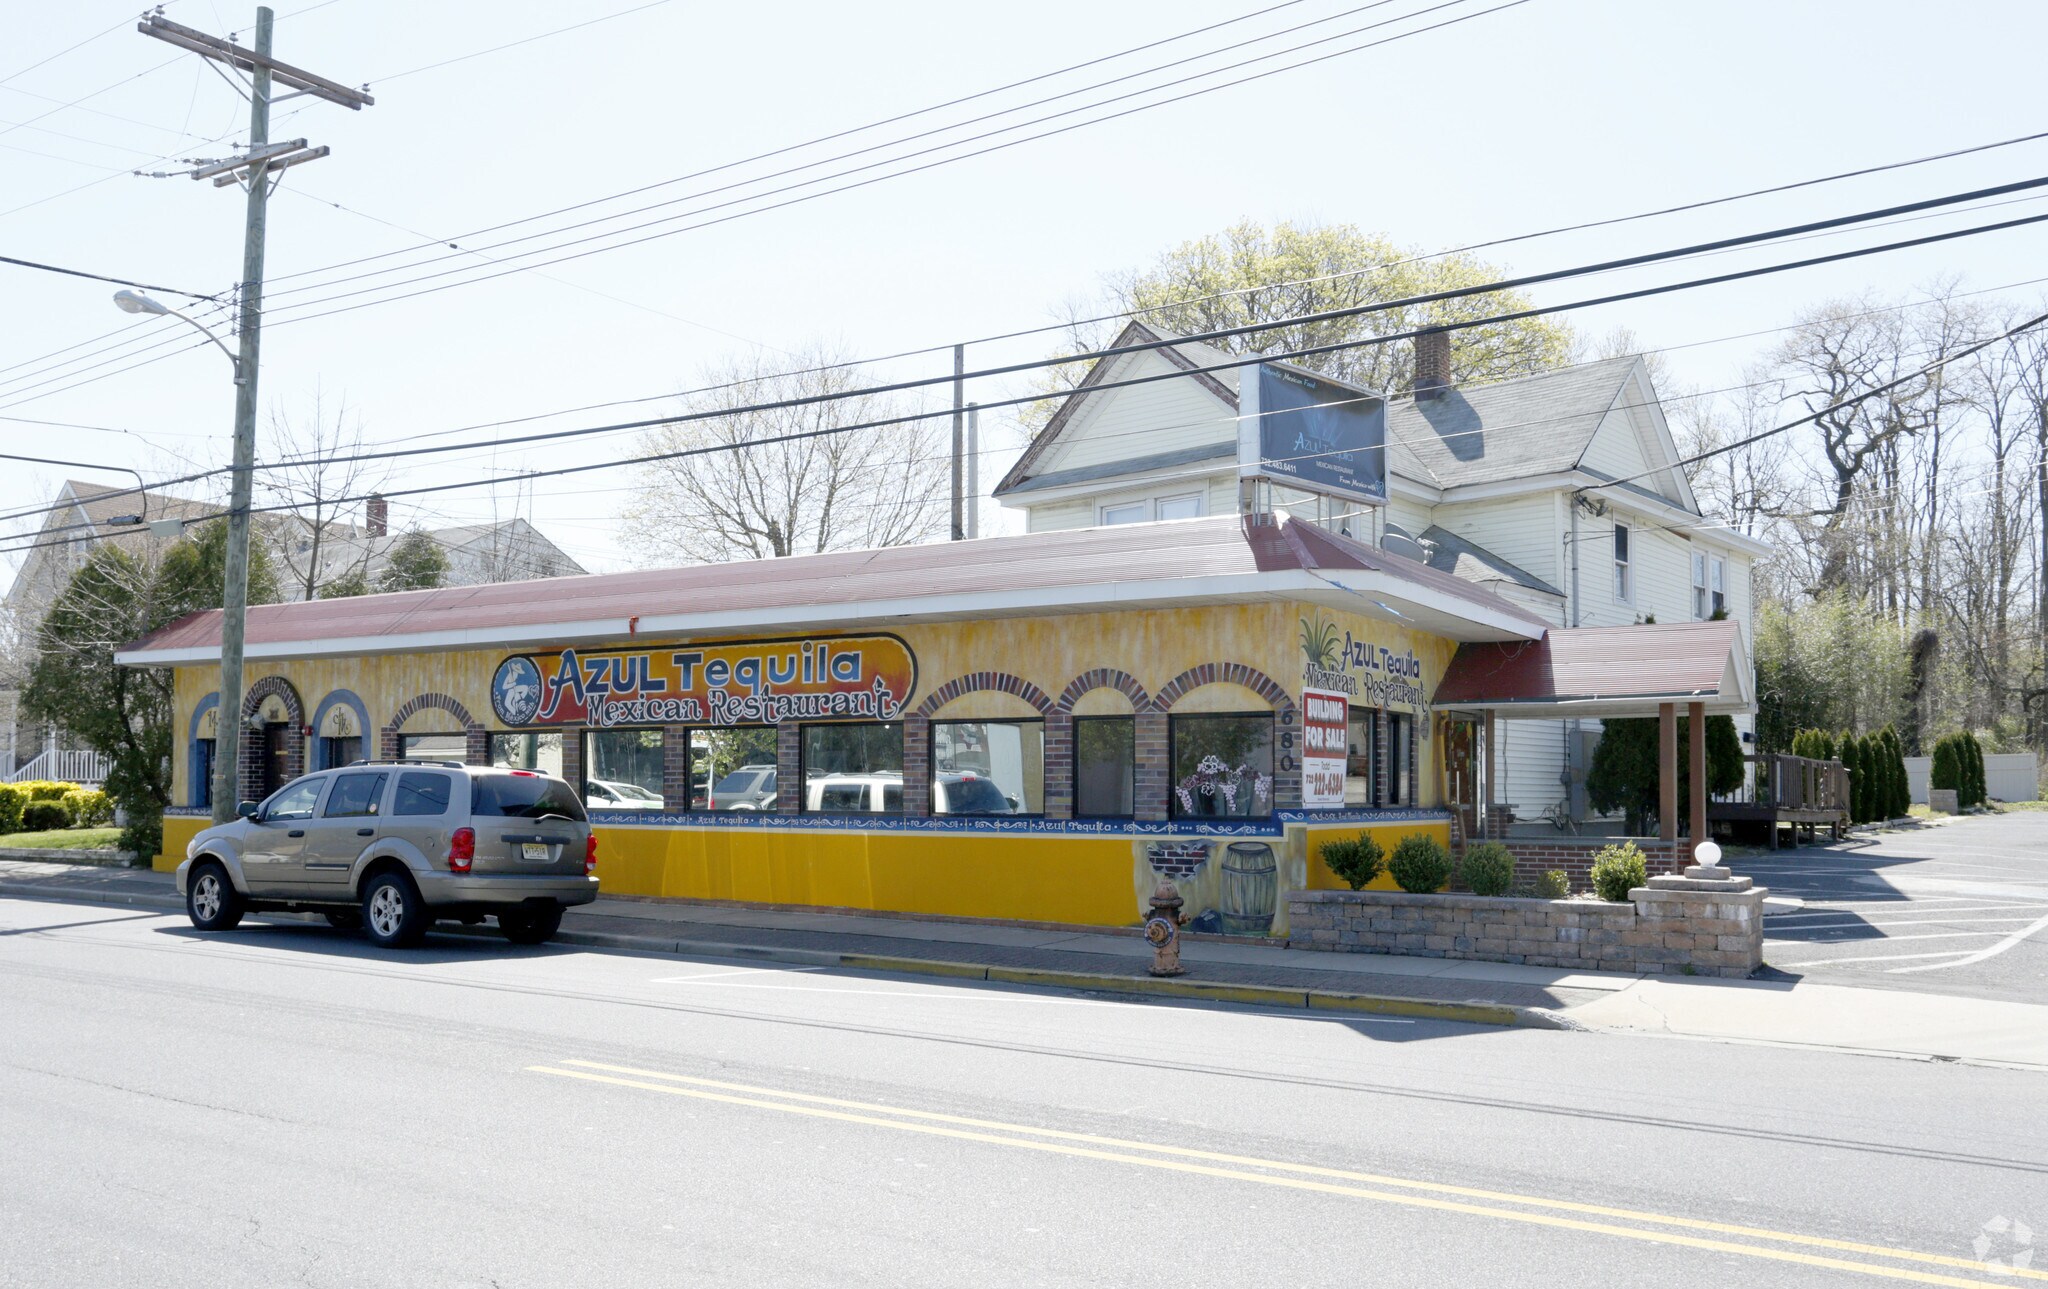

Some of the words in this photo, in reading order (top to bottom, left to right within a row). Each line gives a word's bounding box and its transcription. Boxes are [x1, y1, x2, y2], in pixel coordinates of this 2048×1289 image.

[1283, 372, 1302, 385] Mexican
[1303, 378, 1317, 389] Food
[672, 640, 862, 696] Tequila
[1379, 647, 1420, 679] Tequila
[1304, 662, 1358, 696] Mexican
[1364, 672, 1426, 710] Restaurant
[586, 693, 702, 728] Mexican
[709, 675, 900, 725] Restaurant
[1307, 698, 1344, 721] BUILDING
[1305, 726, 1324, 748] FOR
[1325, 728, 1346, 749] SALE
[719, 814, 749, 825] Tequila
[1035, 820, 1066, 831] Azul
[1068, 821, 1112, 832] Tequila
